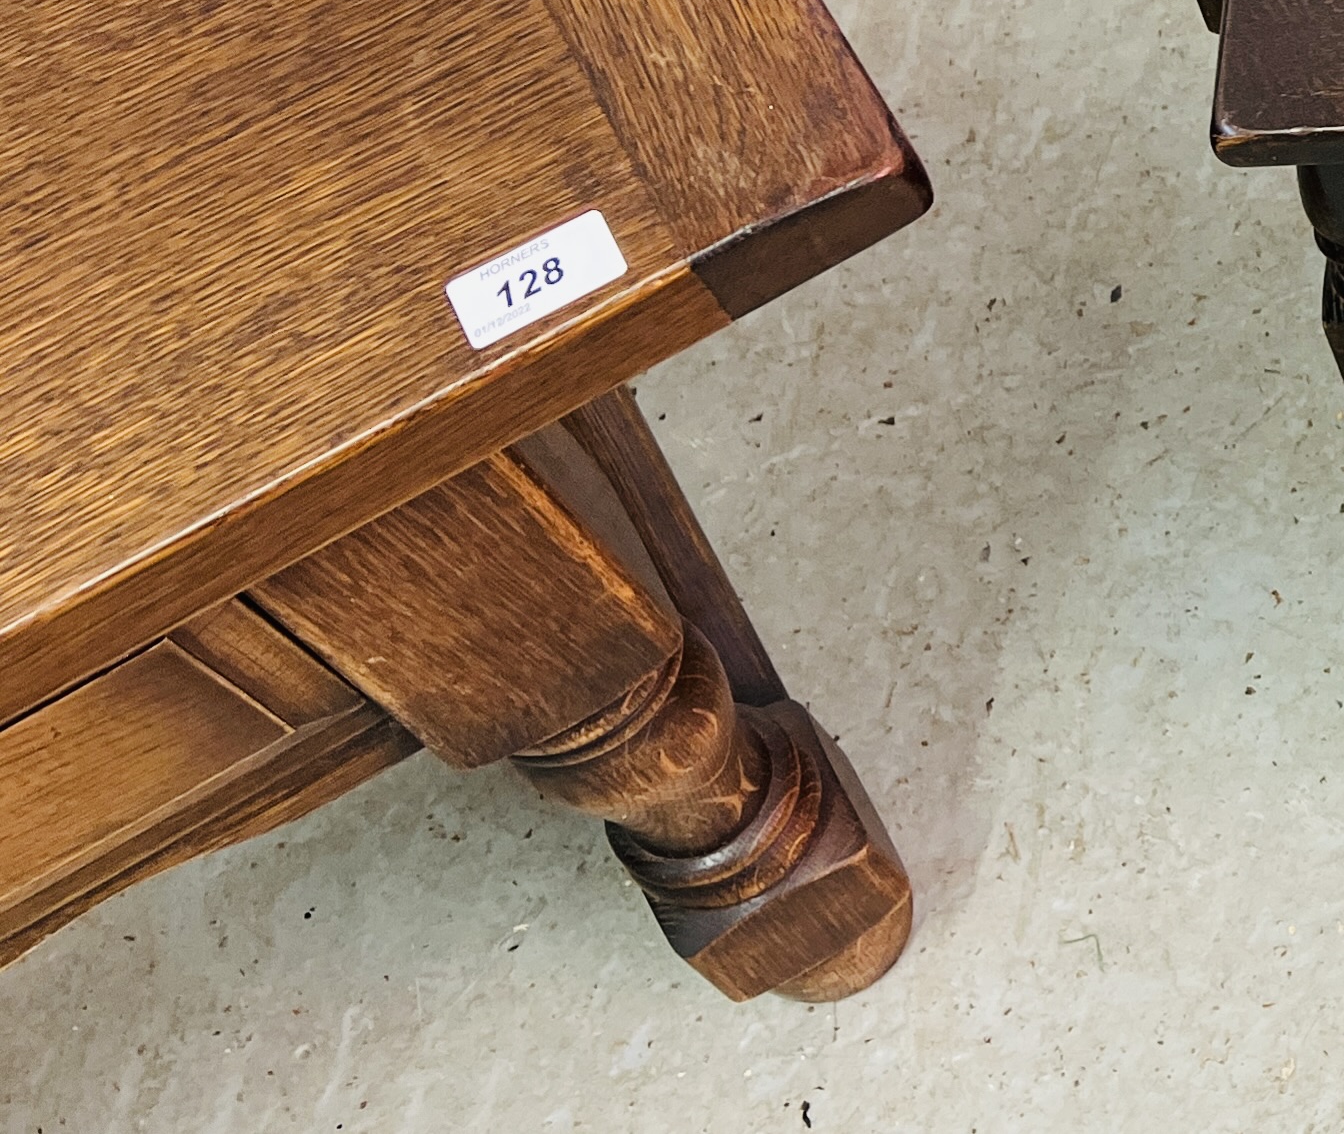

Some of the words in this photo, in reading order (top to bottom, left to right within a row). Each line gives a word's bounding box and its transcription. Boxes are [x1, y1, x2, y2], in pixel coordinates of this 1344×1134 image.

[479, 239, 550, 280] HORNERS
[497, 257, 564, 307] 128
[474, 303, 531, 338] 01/12/2022
